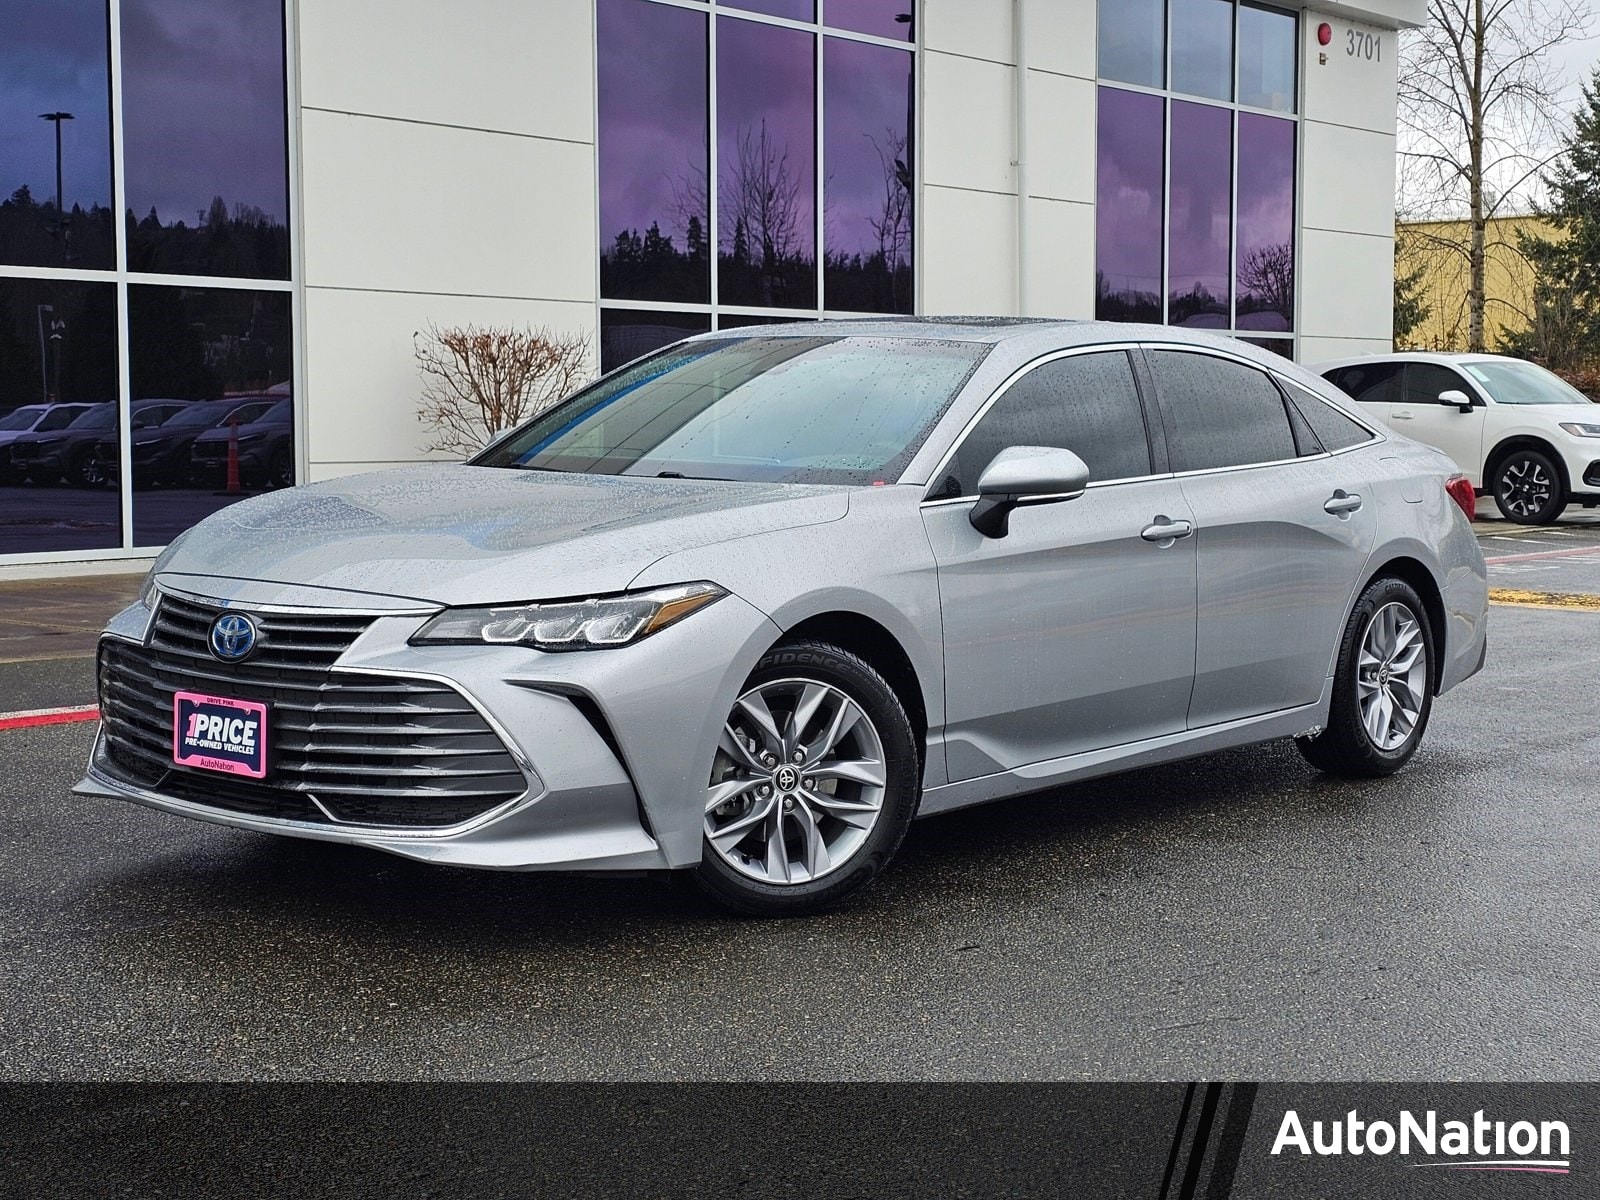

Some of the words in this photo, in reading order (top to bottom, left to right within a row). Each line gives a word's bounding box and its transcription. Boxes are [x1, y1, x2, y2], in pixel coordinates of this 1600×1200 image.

[1346, 28, 1381, 62] 3701
[755, 652, 852, 674] FIDENCE
[206, 697, 222, 705] DRIVE
[222, 699, 235, 707] PINK
[186, 713, 258, 747] 1PRICE
[184, 737, 222, 750] PRE-OWNED
[223, 743, 255, 755] VEHICLES
[199, 758, 235, 771] AutoNation
